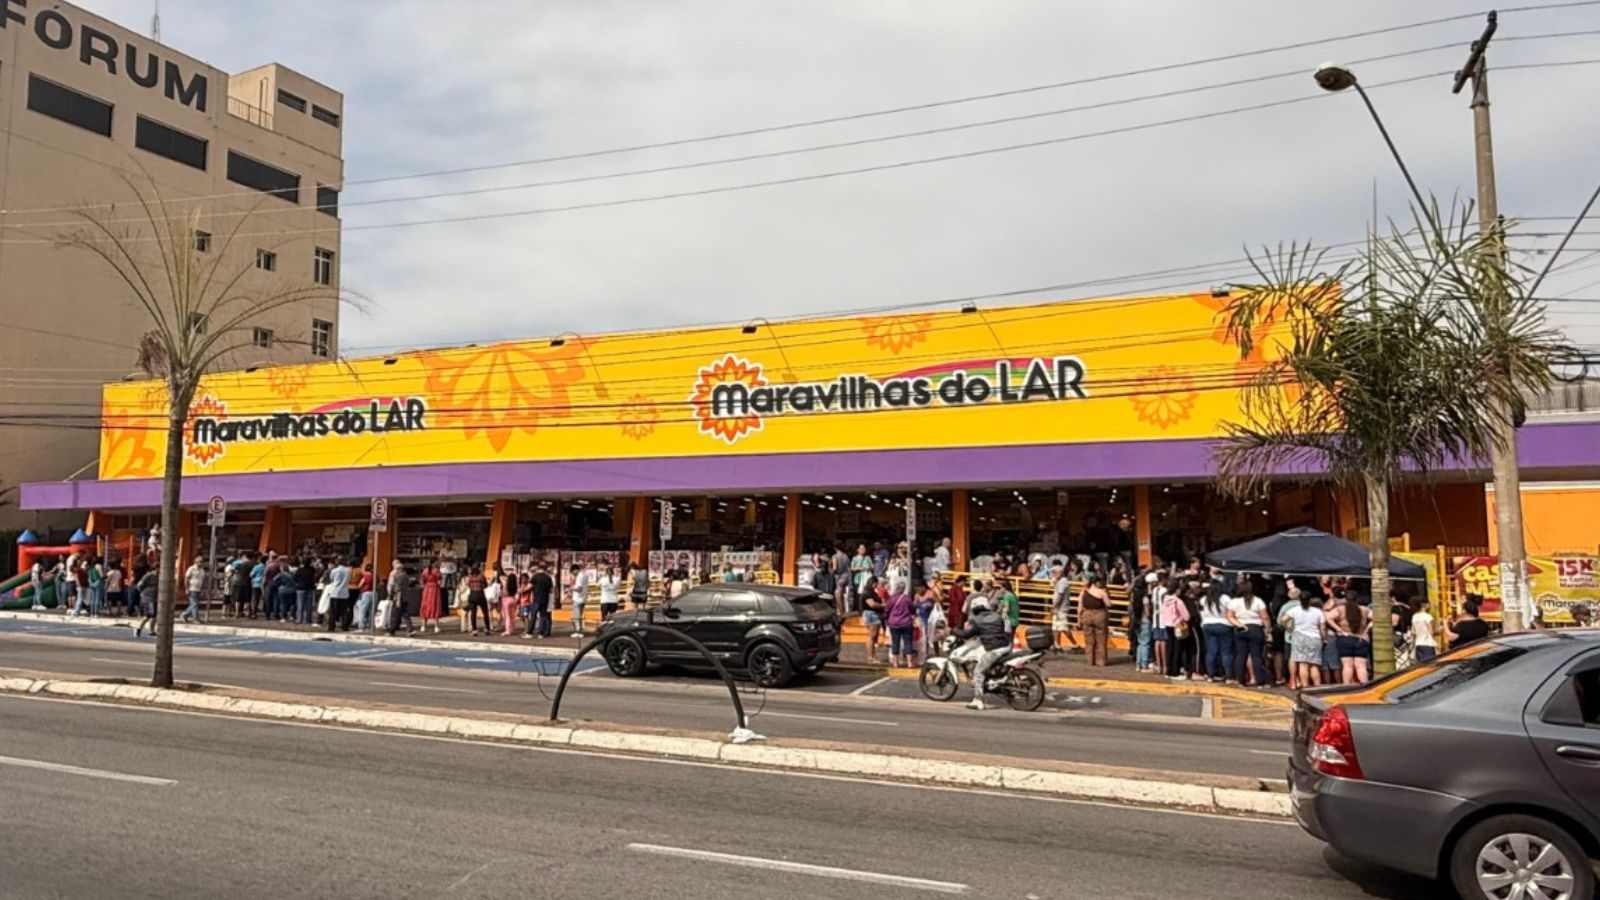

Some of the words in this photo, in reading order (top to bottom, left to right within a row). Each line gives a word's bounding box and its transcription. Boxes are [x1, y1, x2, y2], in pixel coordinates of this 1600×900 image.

[0, 0, 207, 112] FÓRUM
[938, 371, 991, 406] do
[997, 358, 1088, 402] LAR
[333, 410, 366, 434] do
[369, 398, 426, 433] LAR
